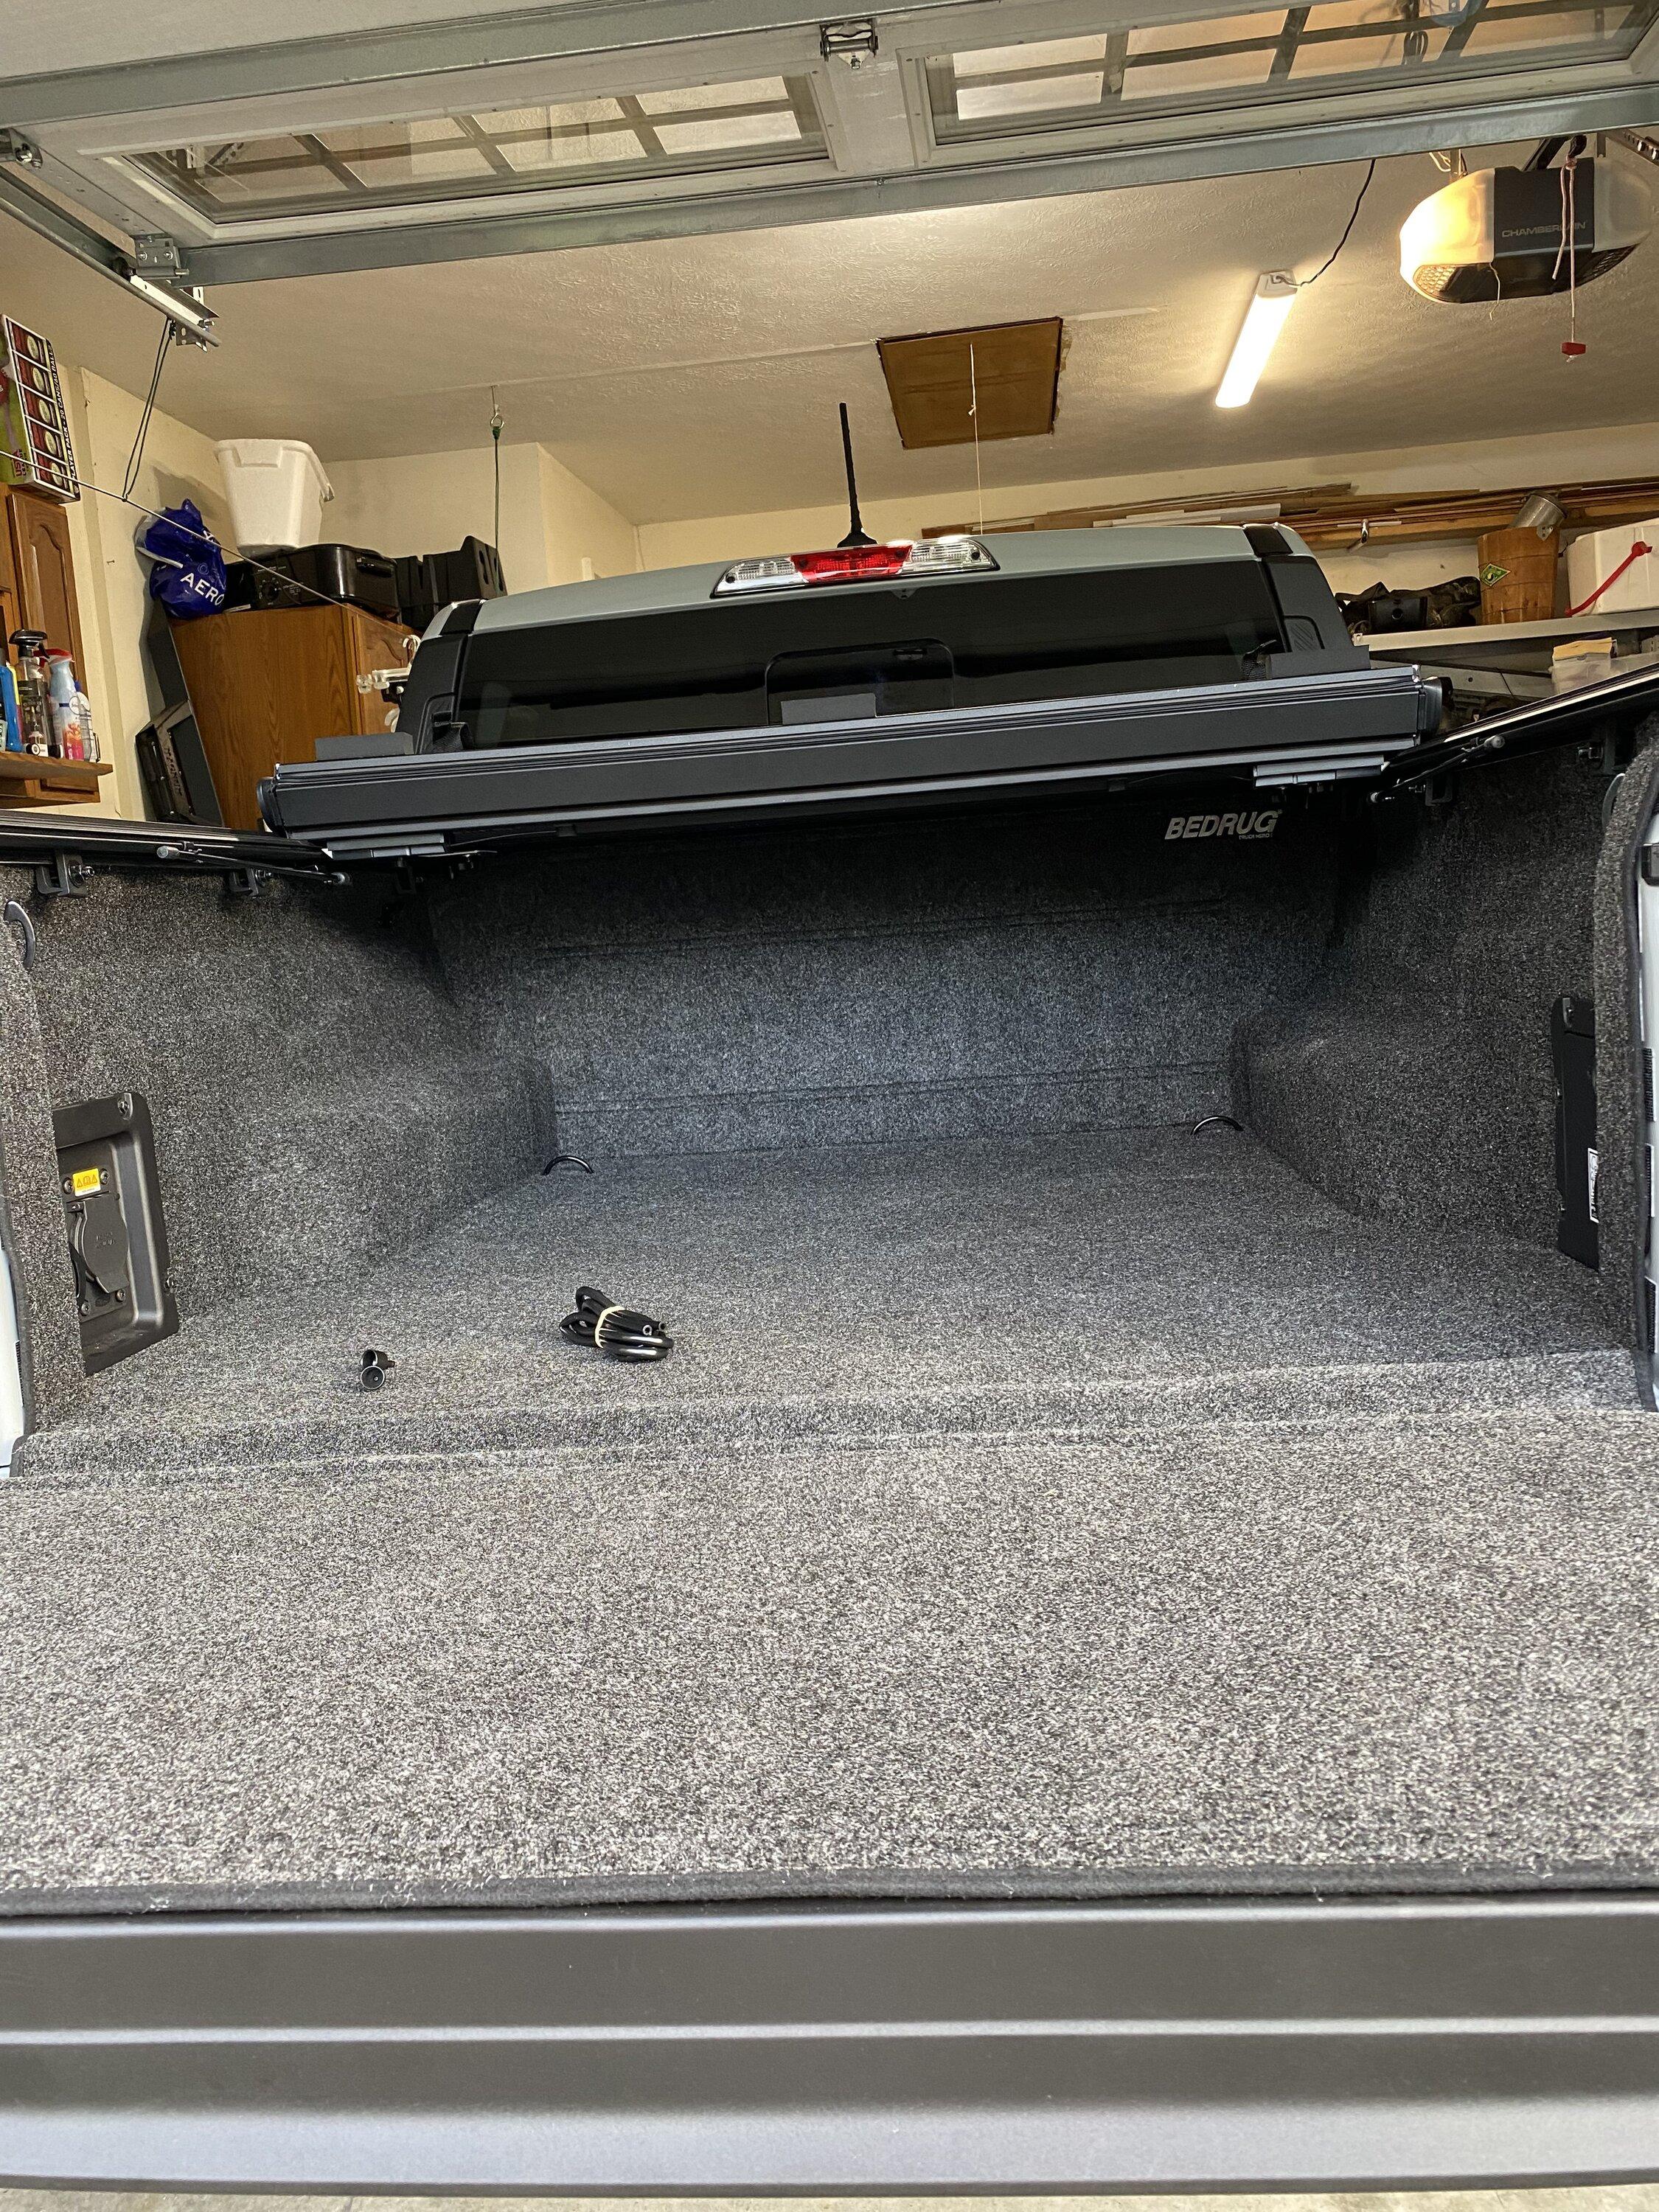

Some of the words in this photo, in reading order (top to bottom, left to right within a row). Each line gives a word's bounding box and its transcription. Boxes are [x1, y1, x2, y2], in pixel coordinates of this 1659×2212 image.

[60, 410, 66, 420] 20
[63, 425, 72, 448] PACK
[180, 573, 225, 606] AERO
[1164, 810, 1279, 840] BEDRUG
